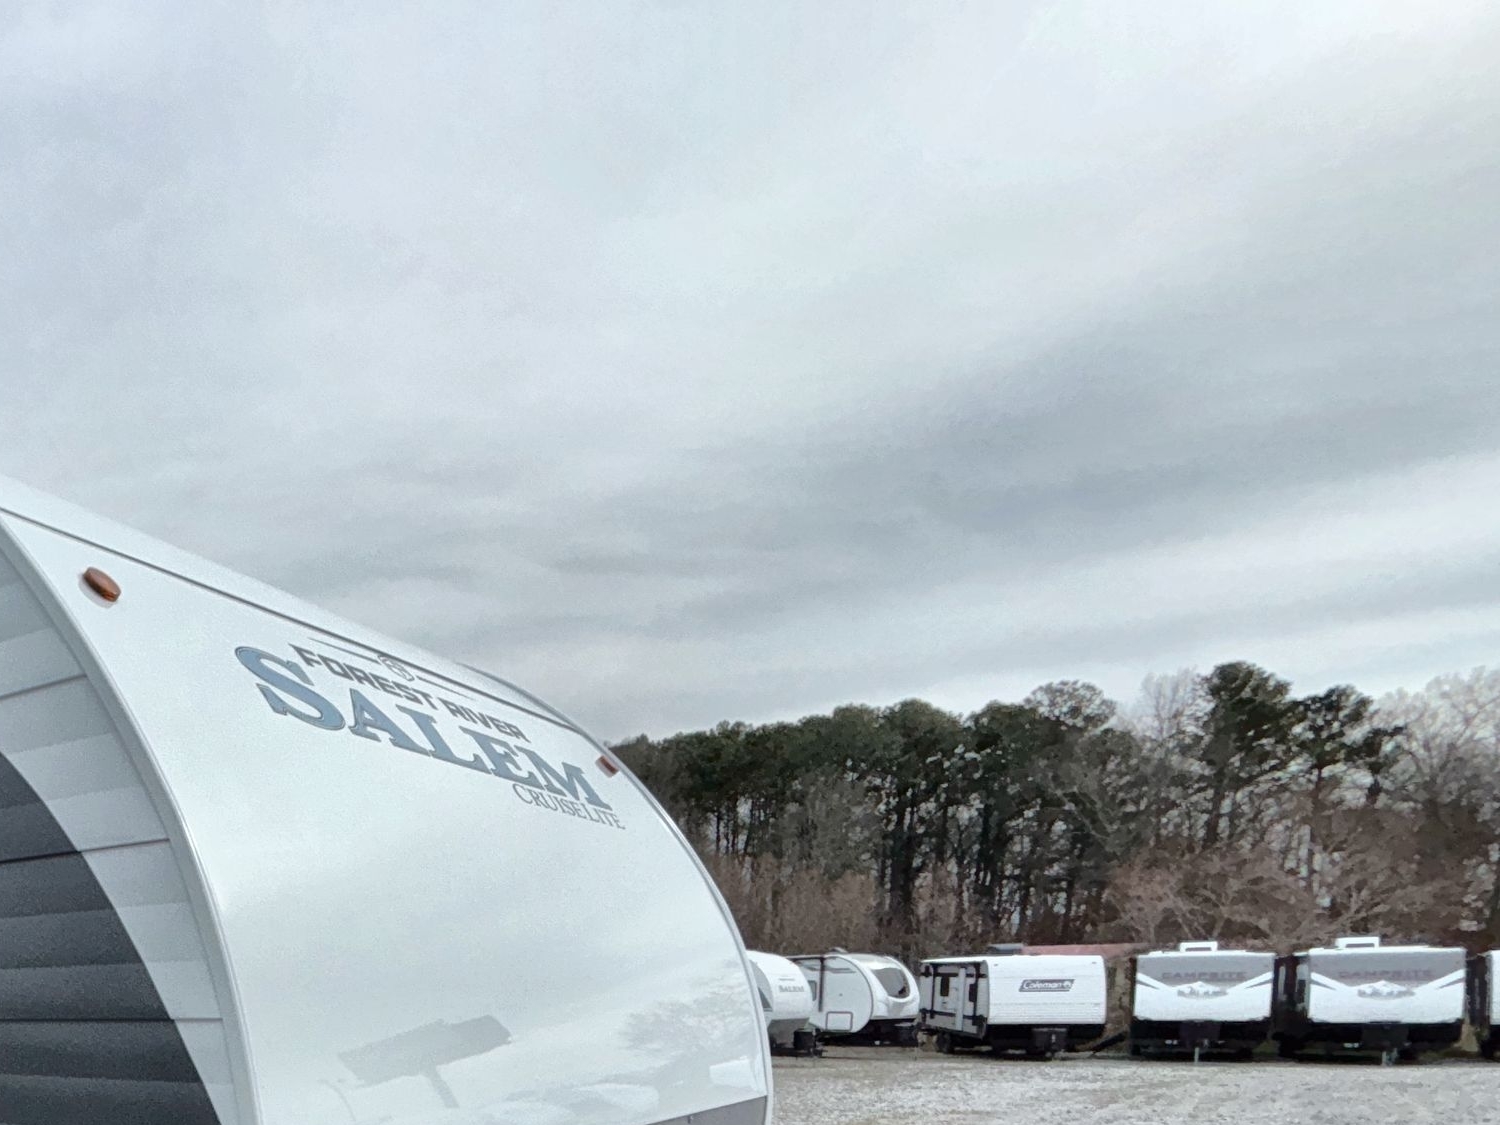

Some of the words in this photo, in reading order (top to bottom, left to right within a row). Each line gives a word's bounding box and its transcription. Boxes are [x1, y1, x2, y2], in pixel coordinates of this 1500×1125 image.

[234, 646, 613, 811] SALEM
[289, 643, 437, 706] FOREST
[439, 698, 530, 742] RIVER
[1022, 980, 1064, 990] Coleman
